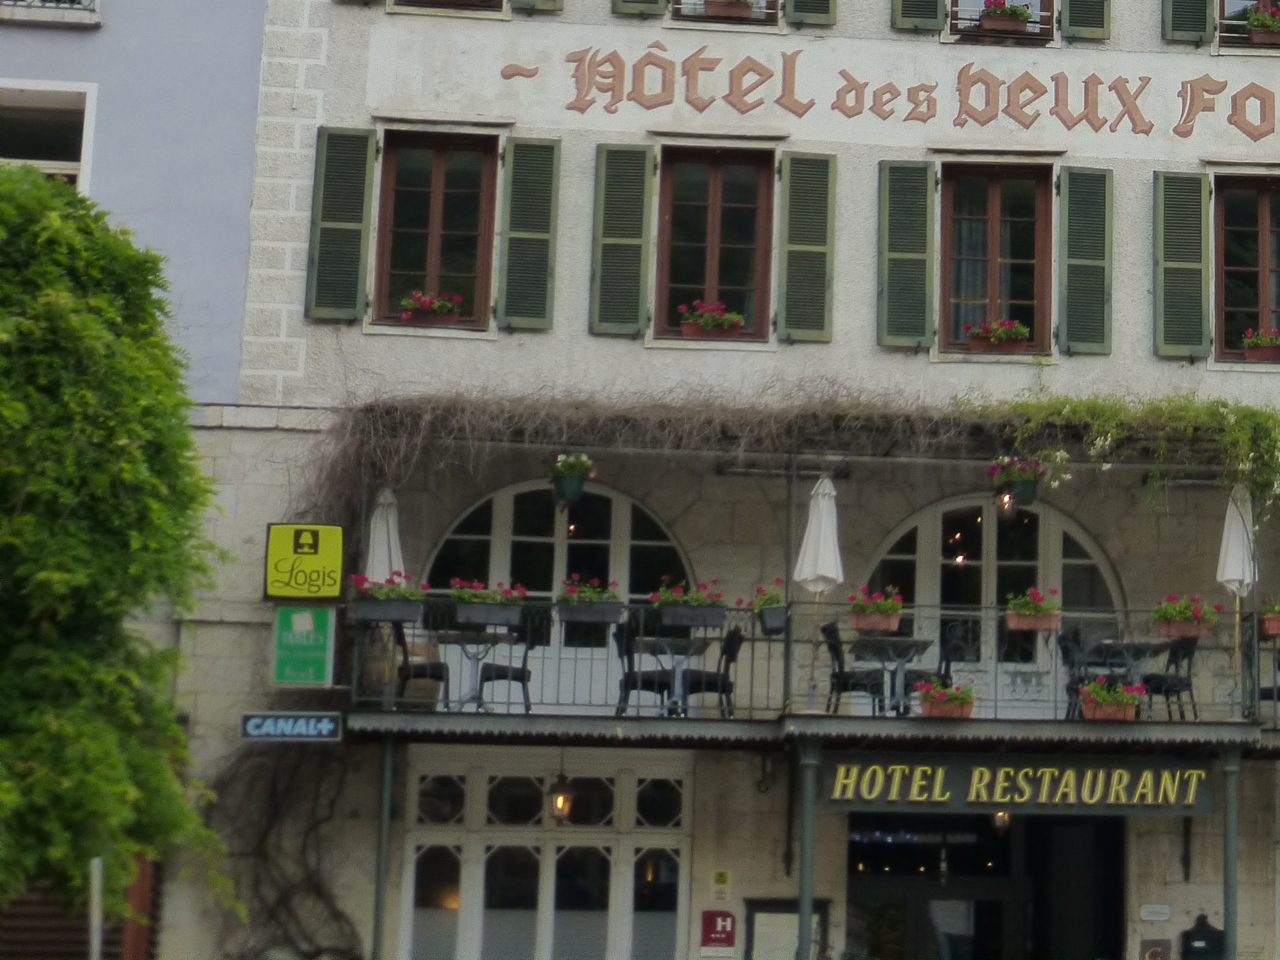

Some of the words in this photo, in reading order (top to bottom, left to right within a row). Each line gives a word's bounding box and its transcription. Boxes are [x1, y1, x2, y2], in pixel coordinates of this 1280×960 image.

[565, 40, 816, 119] Hôtel
[830, 68, 938, 123] des
[952, 61, 1155, 137] Deux
[270, 556, 337, 594] Logis
[246, 717, 336, 736] CANAL+
[831, 763, 951, 801] HOTEL
[966, 767, 1206, 806] RESTAURANT
[716, 917, 732, 932] H
